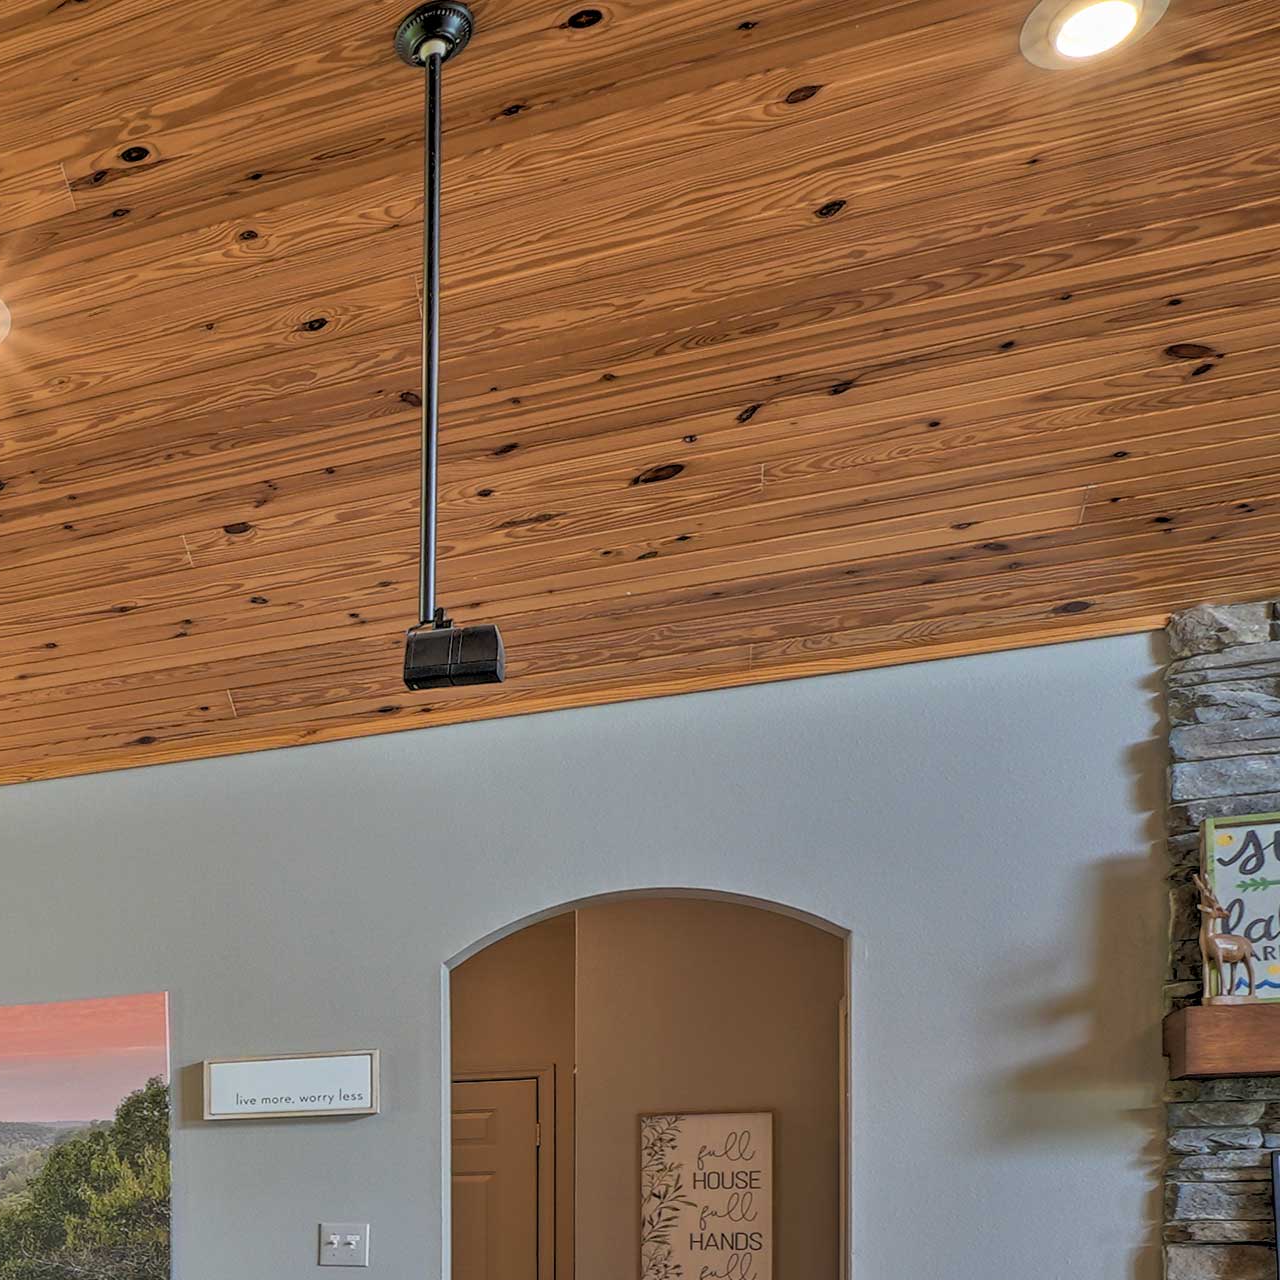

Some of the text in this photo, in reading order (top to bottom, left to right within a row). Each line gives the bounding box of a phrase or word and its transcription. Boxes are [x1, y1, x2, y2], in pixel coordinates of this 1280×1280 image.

[236, 1092, 257, 1105] live
[299, 1093, 335, 1105] worry
[339, 1088, 364, 1101] less
[697, 1130, 756, 1170] full
[693, 1170, 762, 1190] HOUSE
[699, 1191, 758, 1231] full
[689, 1232, 763, 1251] HANDS
